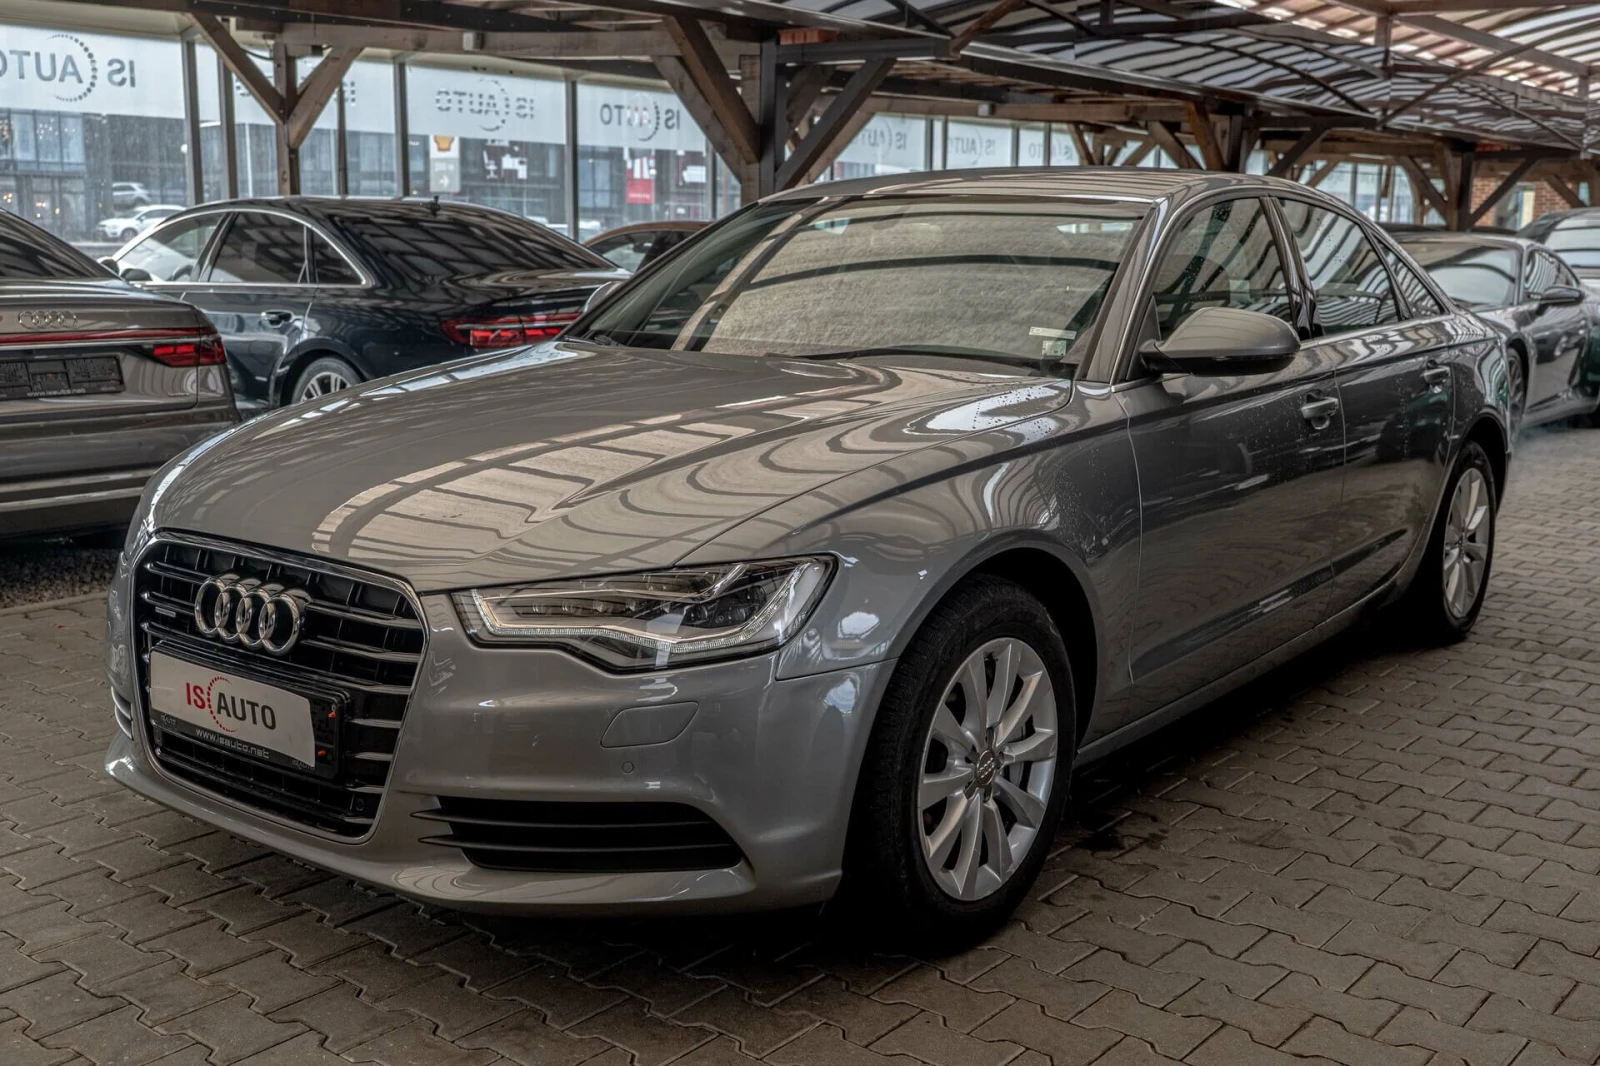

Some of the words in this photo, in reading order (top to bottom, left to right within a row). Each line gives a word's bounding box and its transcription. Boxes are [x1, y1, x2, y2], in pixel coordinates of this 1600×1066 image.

[186, 682, 206, 710] IS
[217, 692, 276, 730] AUTO
[196, 729, 270, 759] www.isauto.net
